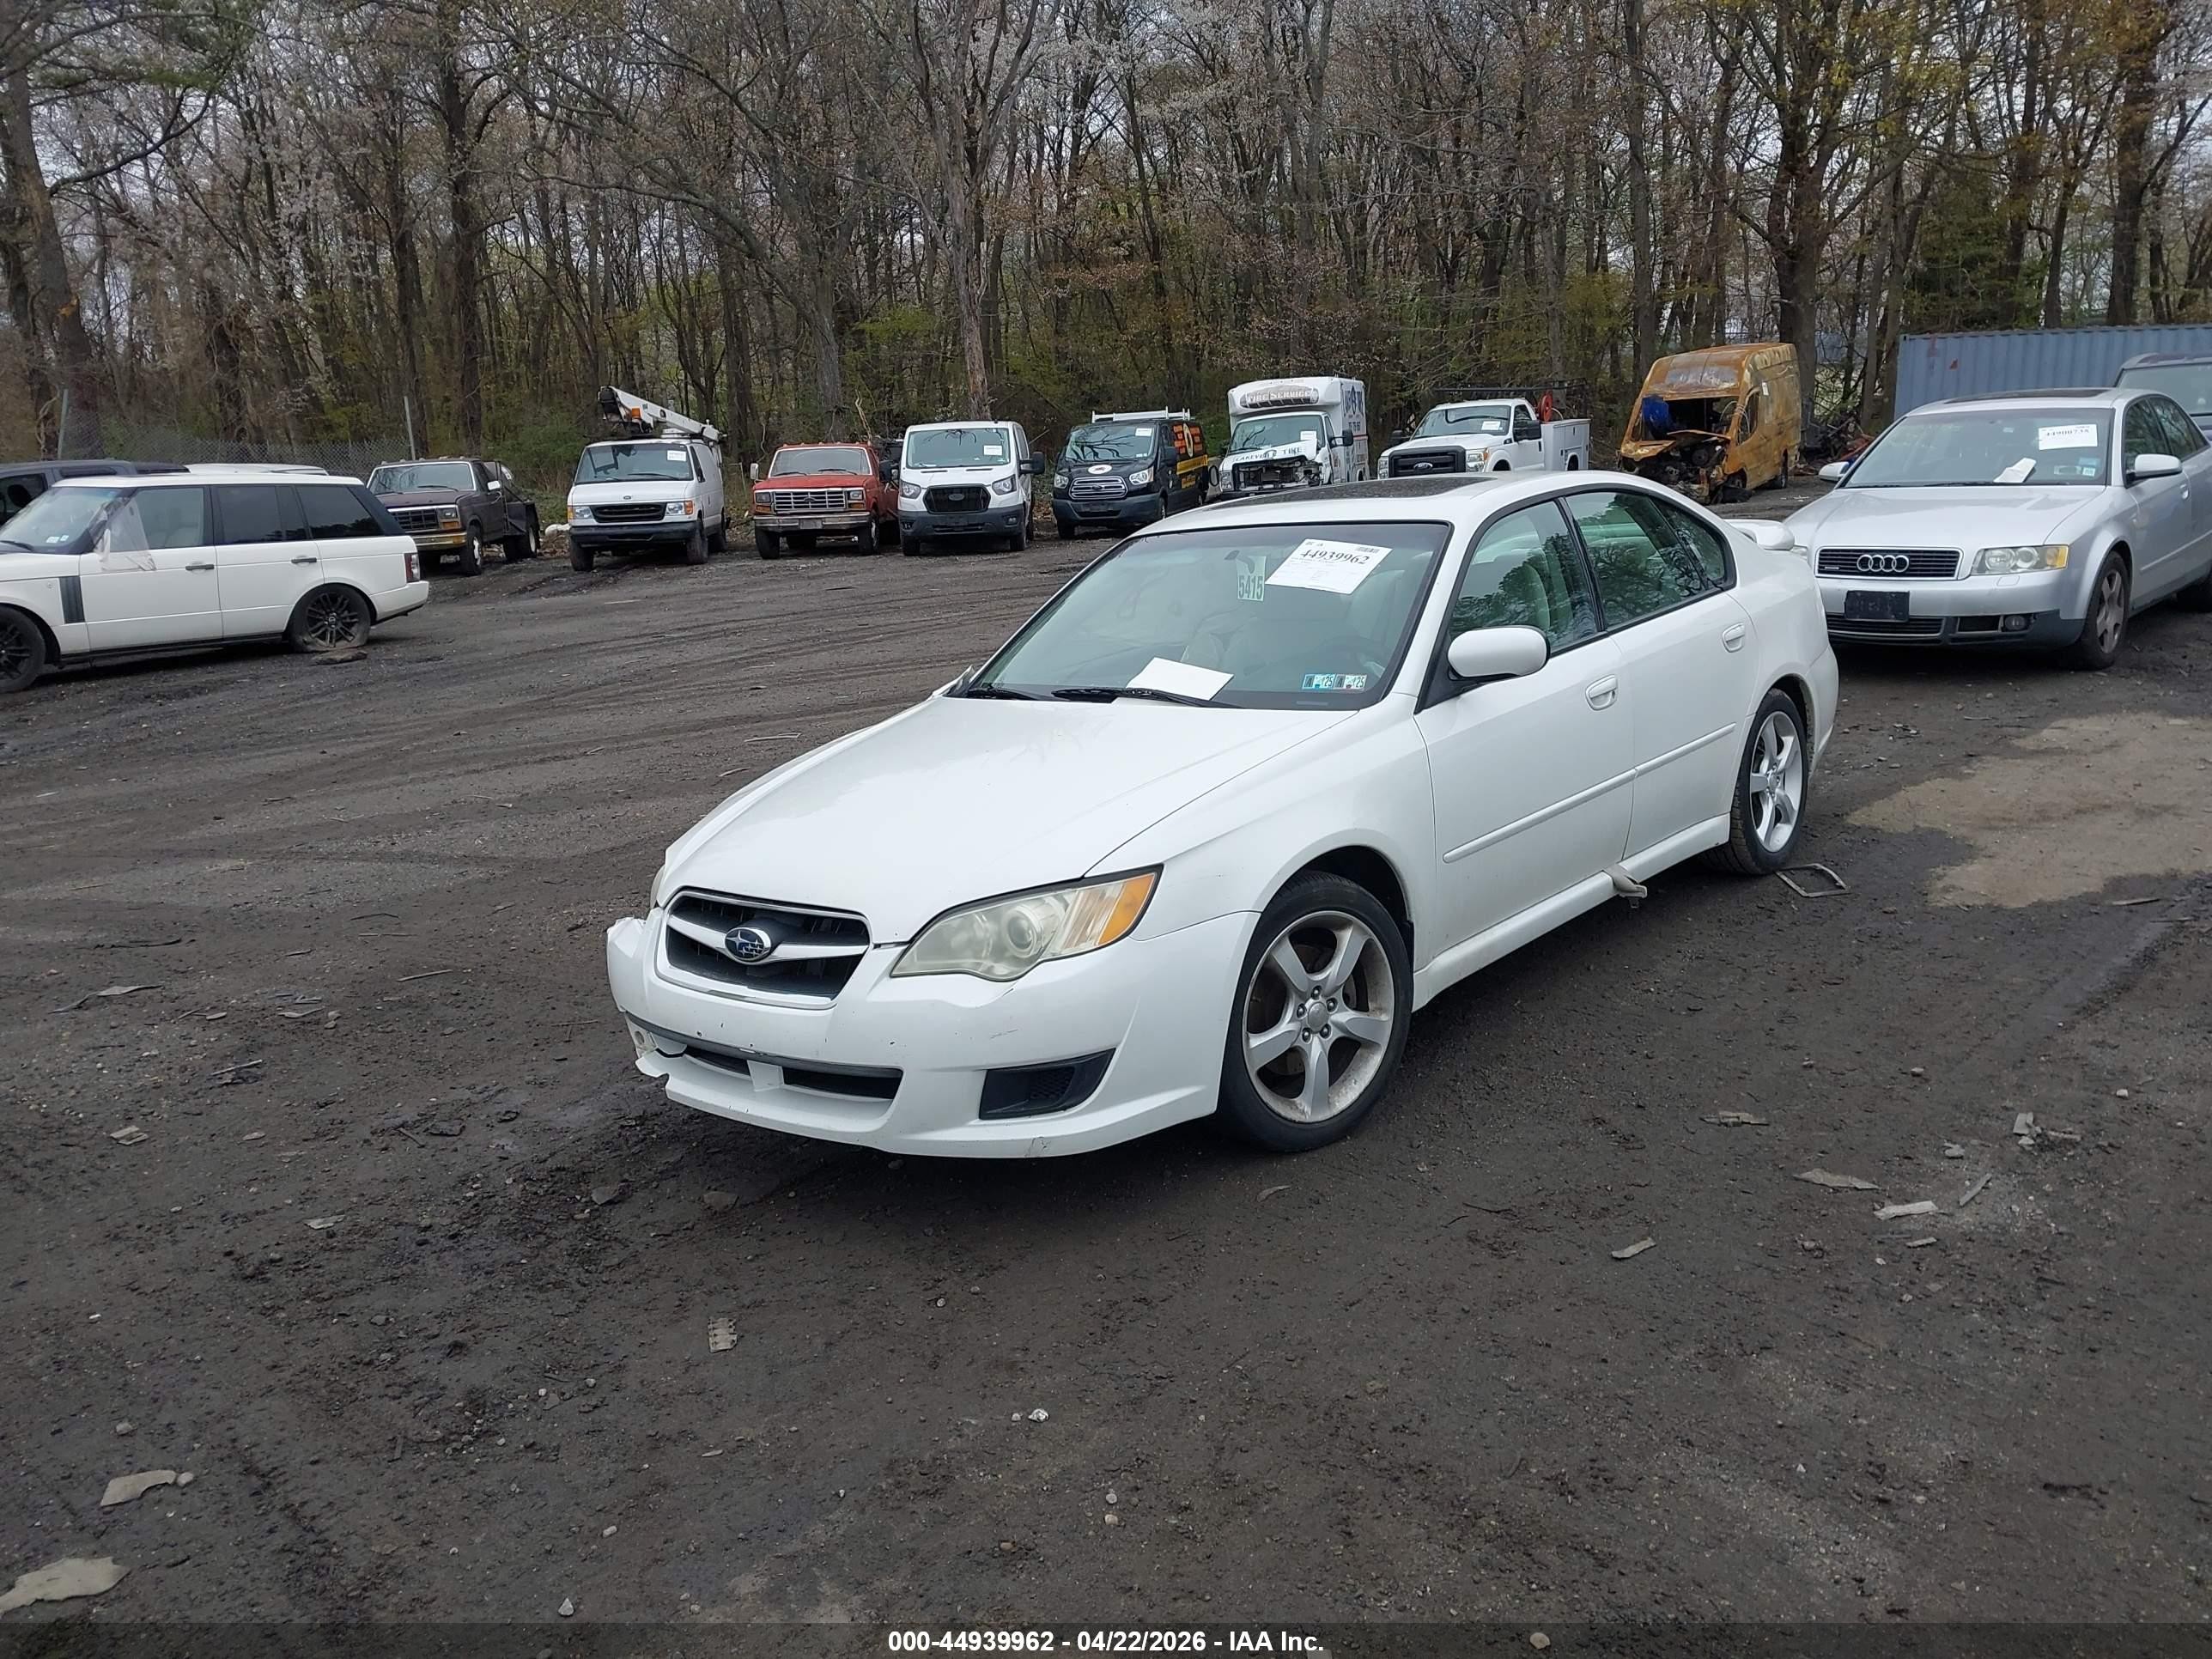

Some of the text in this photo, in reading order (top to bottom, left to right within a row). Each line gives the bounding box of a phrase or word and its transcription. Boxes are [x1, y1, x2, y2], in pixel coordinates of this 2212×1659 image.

[1270, 391, 1310, 399] SERVICE
[1282, 447, 1303, 455] TIRE
[1300, 549, 1371, 565] 44939962
[1239, 574, 1264, 599] 5415
